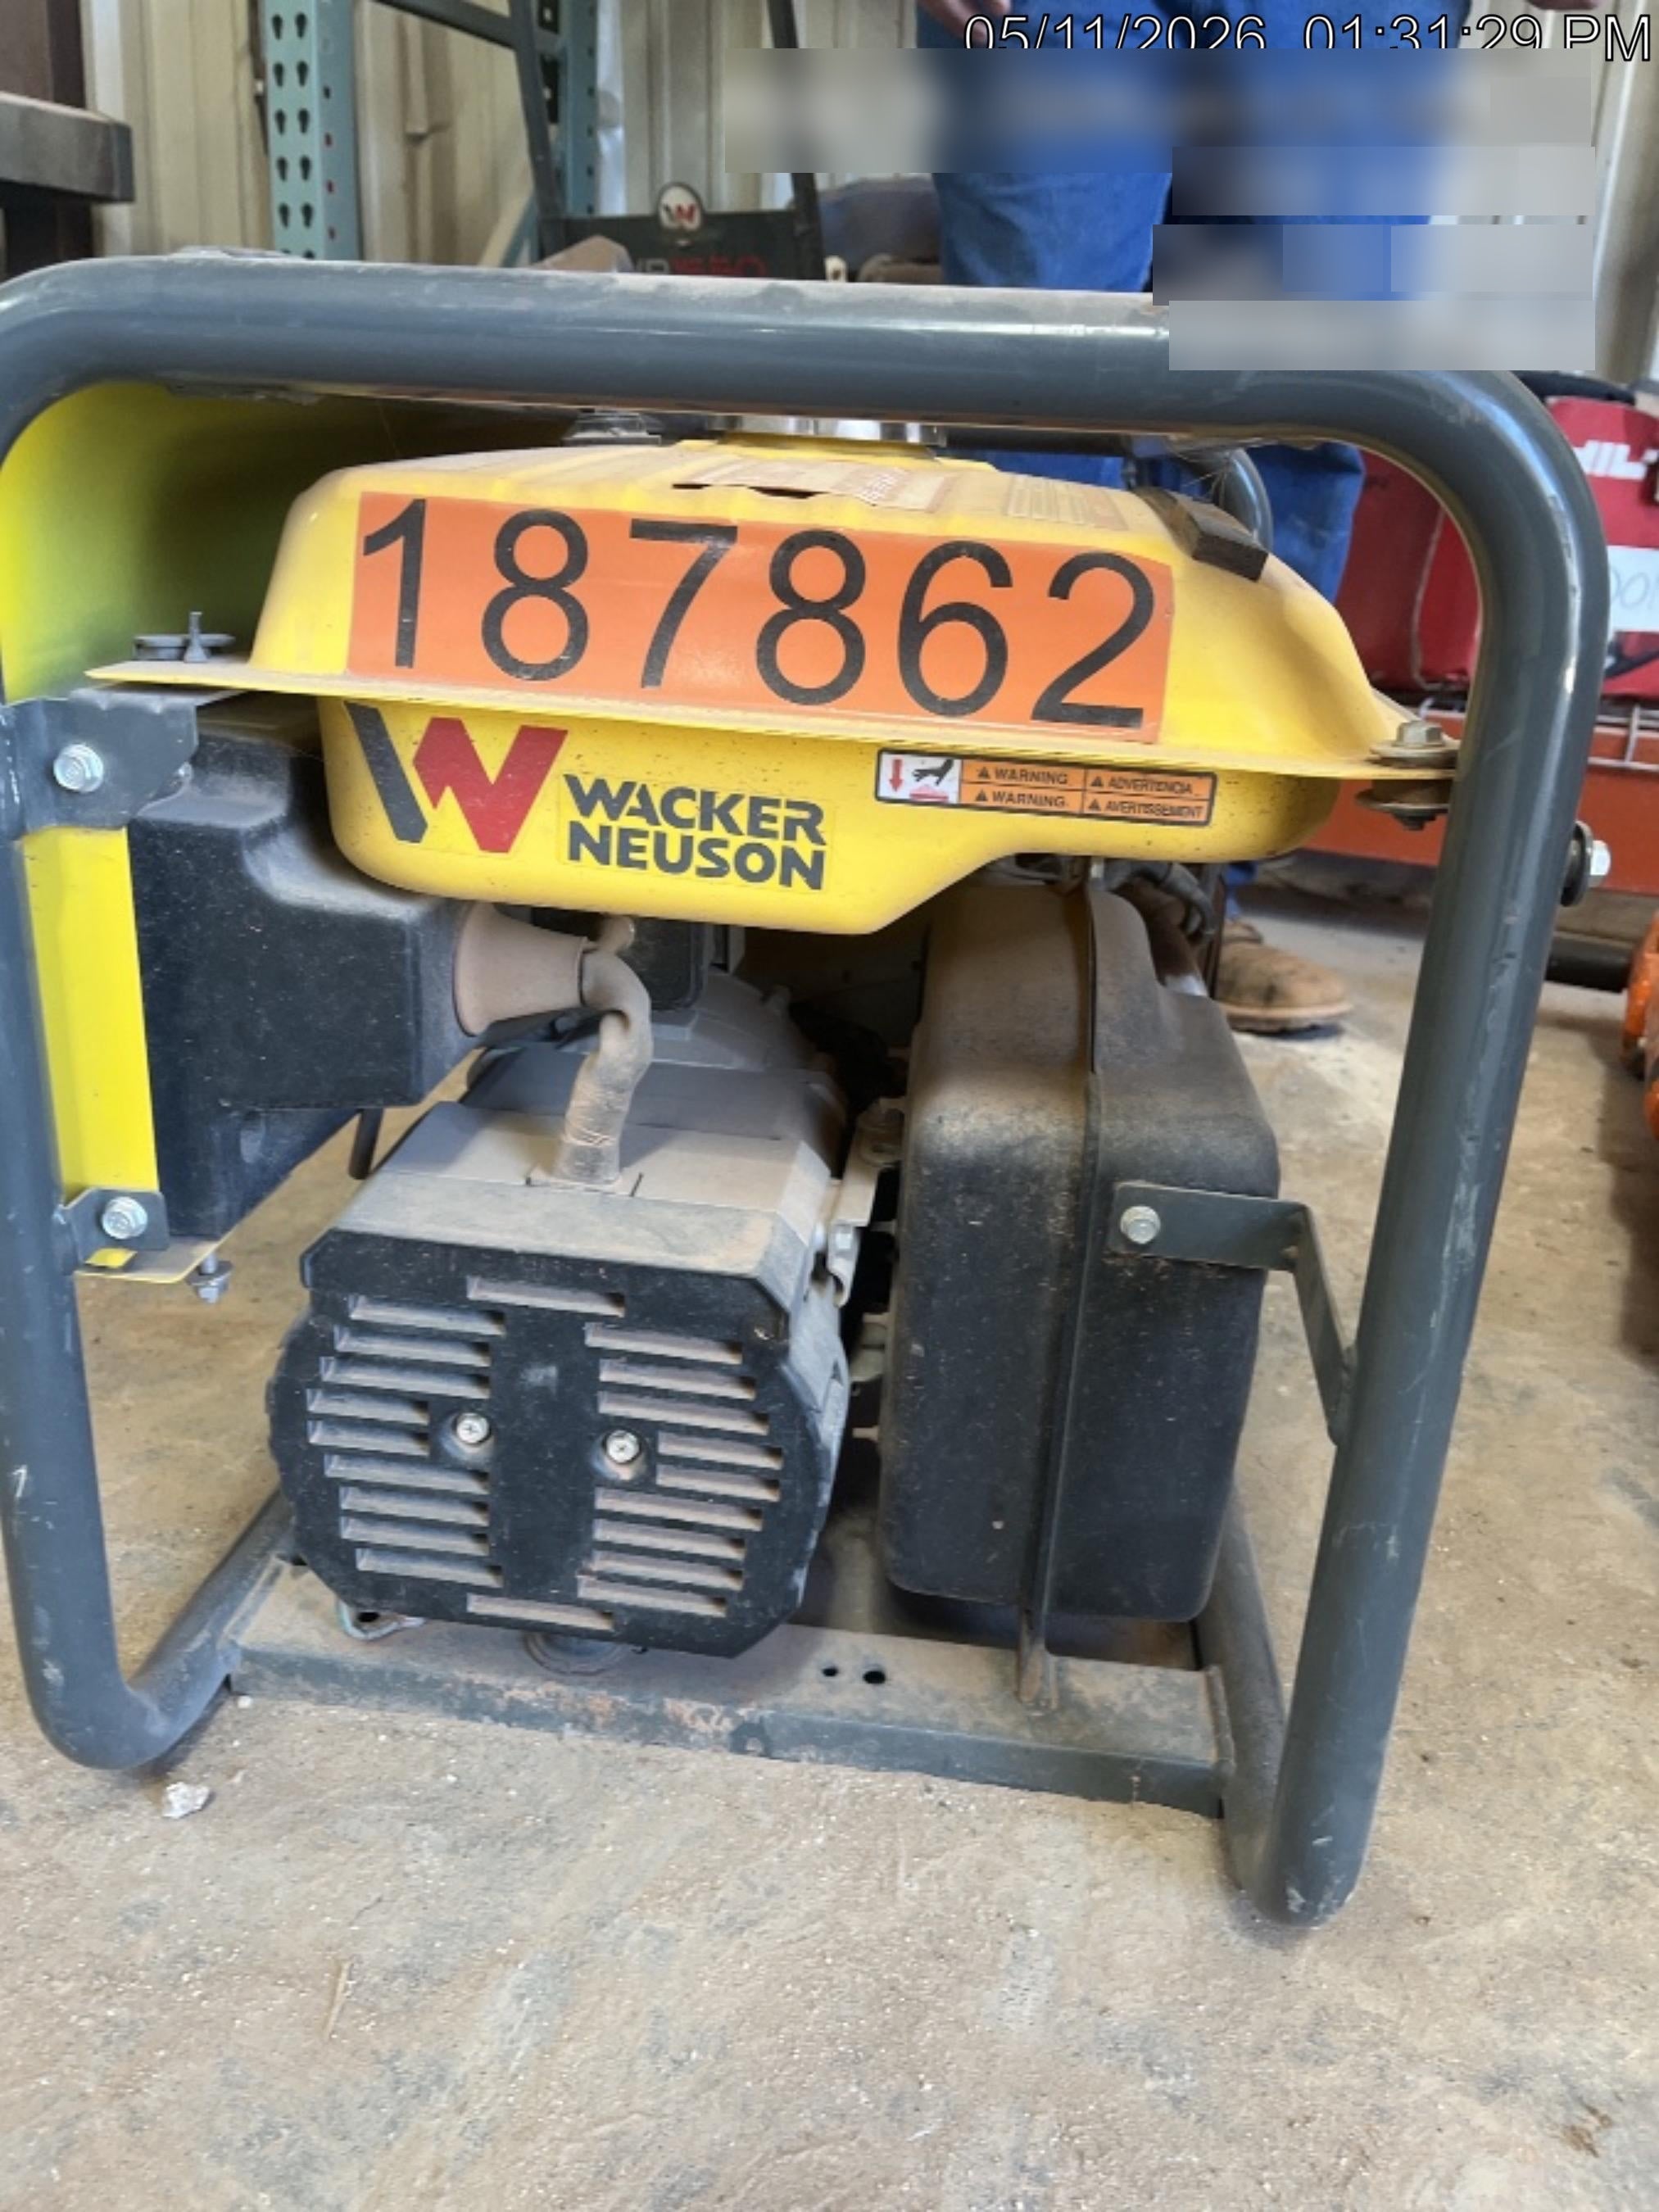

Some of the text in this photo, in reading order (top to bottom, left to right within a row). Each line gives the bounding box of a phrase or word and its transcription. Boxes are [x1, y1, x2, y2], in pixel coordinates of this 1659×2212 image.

[362, 497, 1154, 728] 187862
[563, 773, 827, 846] WACKER
[992, 791, 1066, 808] WARNING
[994, 766, 1068, 785] WARNING
[568, 820, 826, 891] NEUSON
